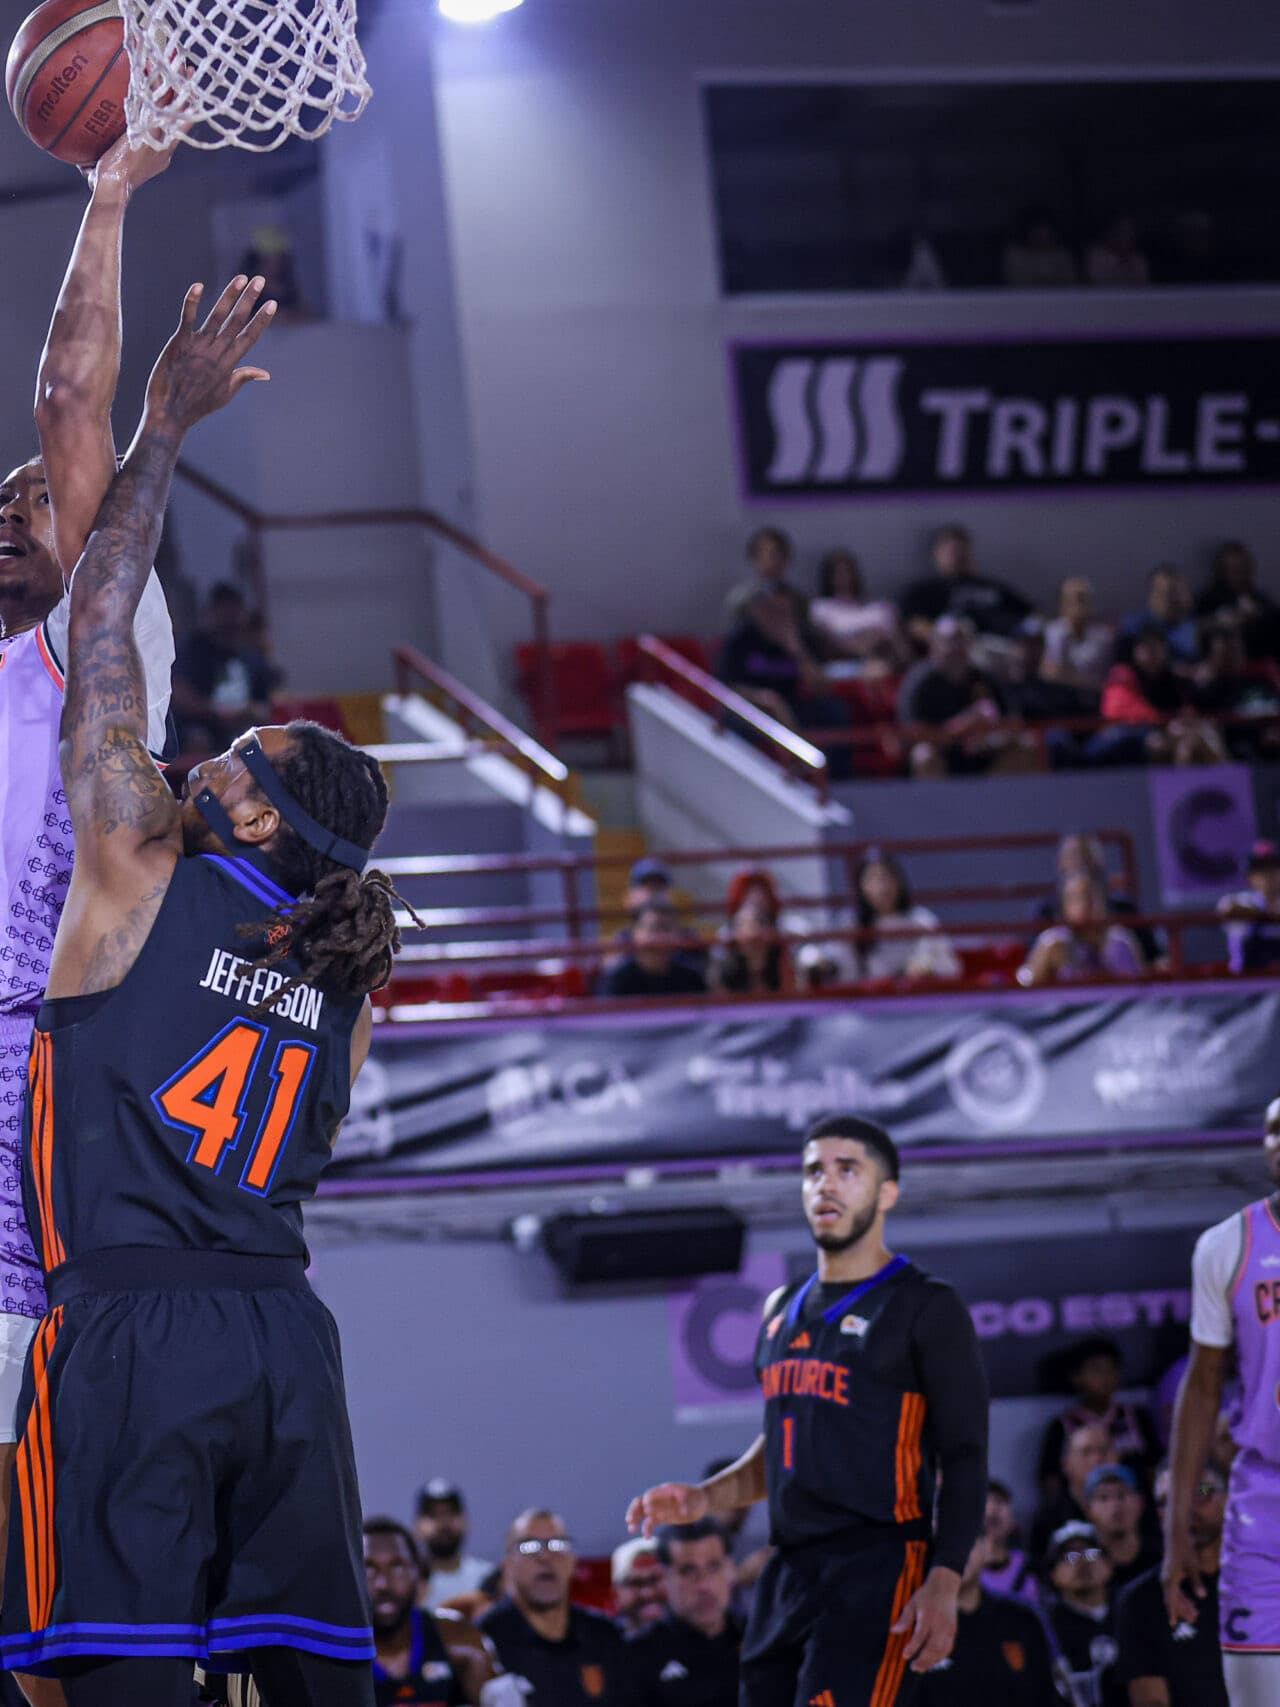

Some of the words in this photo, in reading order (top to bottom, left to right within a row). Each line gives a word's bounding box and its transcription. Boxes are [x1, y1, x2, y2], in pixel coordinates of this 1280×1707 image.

[37, 53, 88, 123] molten
[84, 99, 117, 134] FIBA
[199, 948, 324, 1031] JEFFERSON
[150, 1015, 318, 1198] 41
[783, 1416, 794, 1470] 1
